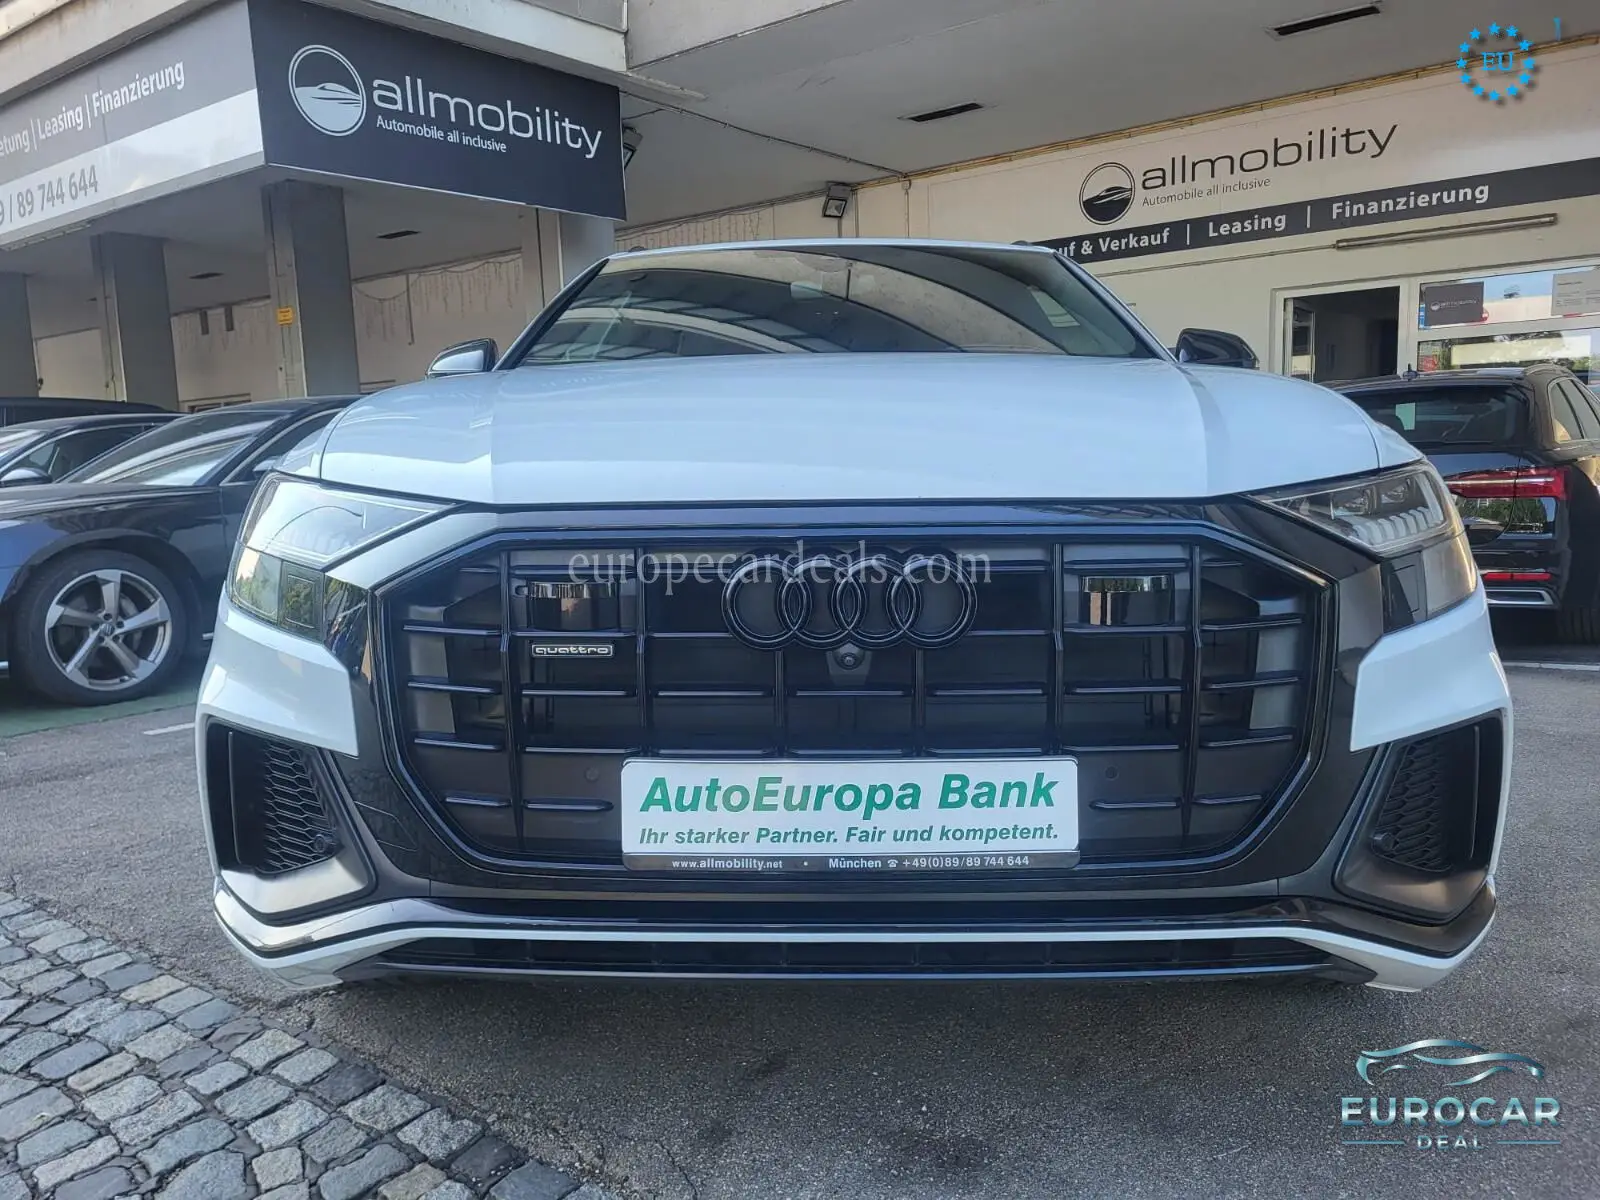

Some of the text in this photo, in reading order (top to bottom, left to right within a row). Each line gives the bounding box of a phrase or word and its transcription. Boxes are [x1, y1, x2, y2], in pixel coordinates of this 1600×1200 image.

[38, 107, 83, 140] Leasing
[93, 61, 185, 117] Finanzierung
[372, 75, 602, 158] allmobility
[376, 116, 507, 153] Automobile all inclusive
[1141, 124, 1398, 190] allmobility
[17, 188, 34, 218] 89
[37, 178, 65, 212] 744
[68, 164, 98, 201] 644
[1142, 177, 1271, 208] Automobile all inclusive
[1081, 240, 1093, 255] &
[1099, 227, 1170, 252] Verkauf
[1208, 212, 1287, 238] Leasing
[1332, 184, 1489, 219] Finanzierung
[535, 646, 609, 656] quattro
[640, 772, 1059, 820] AutoEuropa Bank
[639, 823, 1059, 846] Ihr starker Partner. Fair und kompetent.
[671, 858, 783, 871] www.allmobility.net
[828, 857, 882, 869] München
[983, 856, 1004, 868] 744
[1008, 855, 1030, 867] 644
